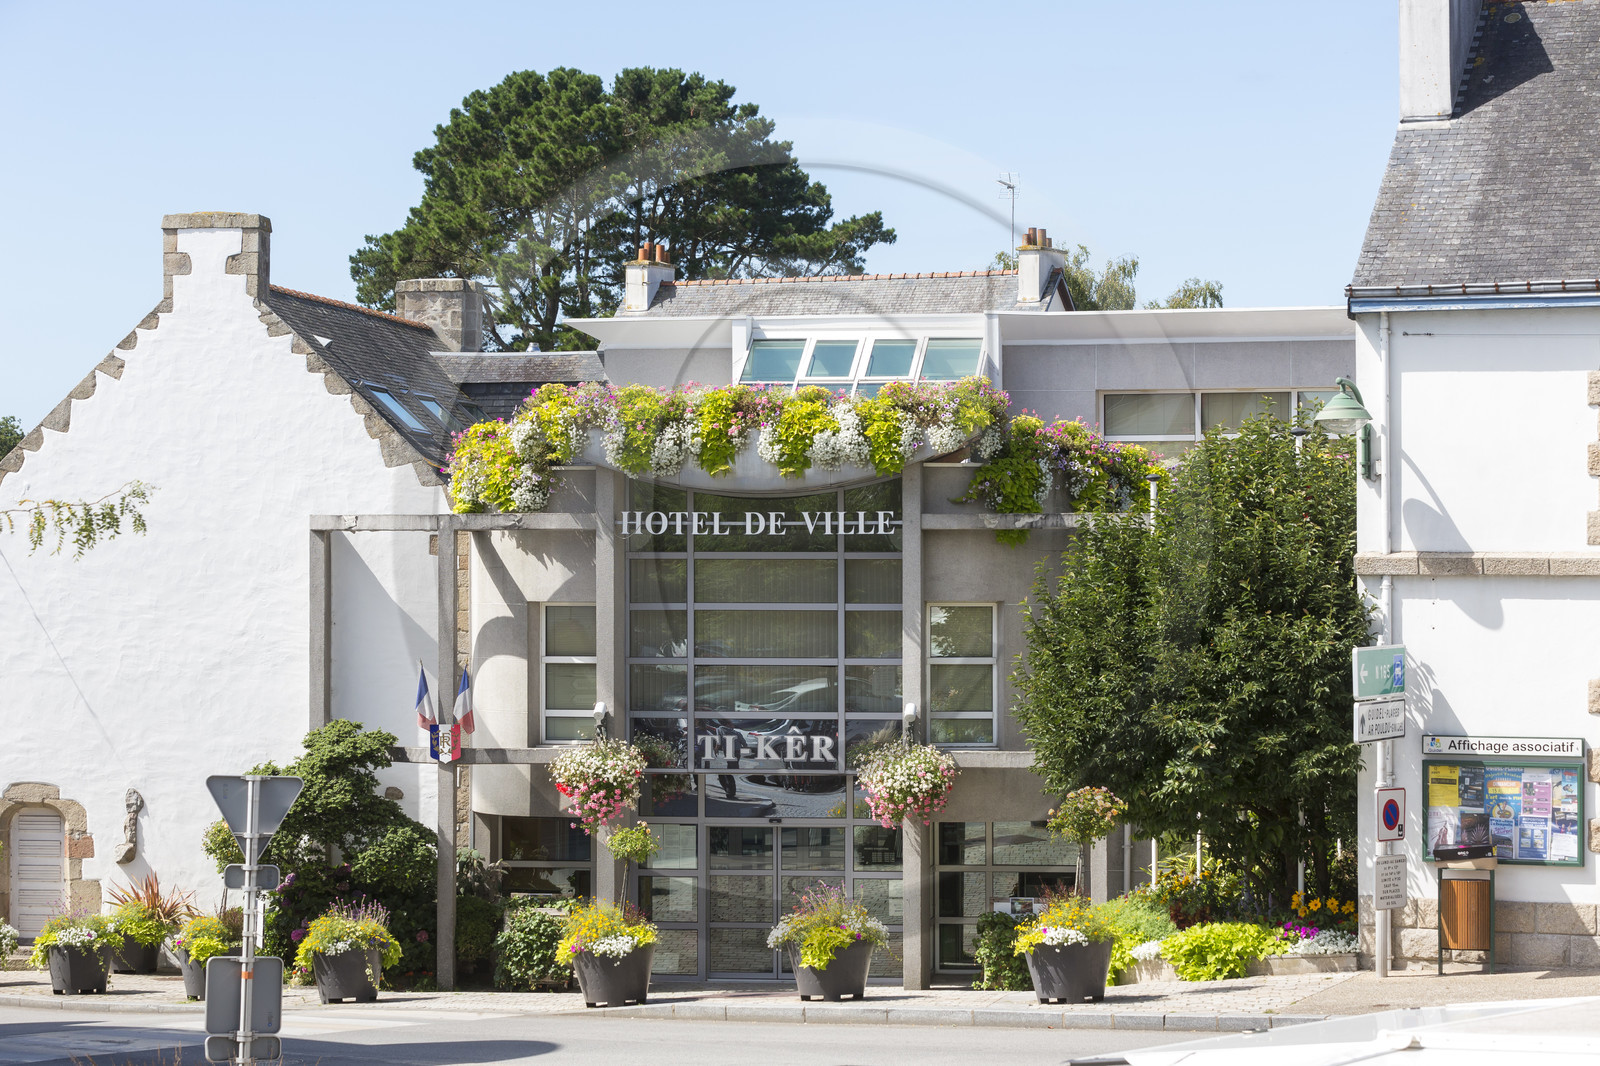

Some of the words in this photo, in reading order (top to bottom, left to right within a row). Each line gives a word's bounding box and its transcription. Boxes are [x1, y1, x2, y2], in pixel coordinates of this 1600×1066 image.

[621, 511, 730, 536] HOTEL
[744, 511, 787, 536] DE
[801, 510, 896, 535] VILLE
[697, 726, 837, 762] TI-KÊR
[1448, 739, 1509, 753] Affichage
[1512, 741, 1574, 753] associatif
